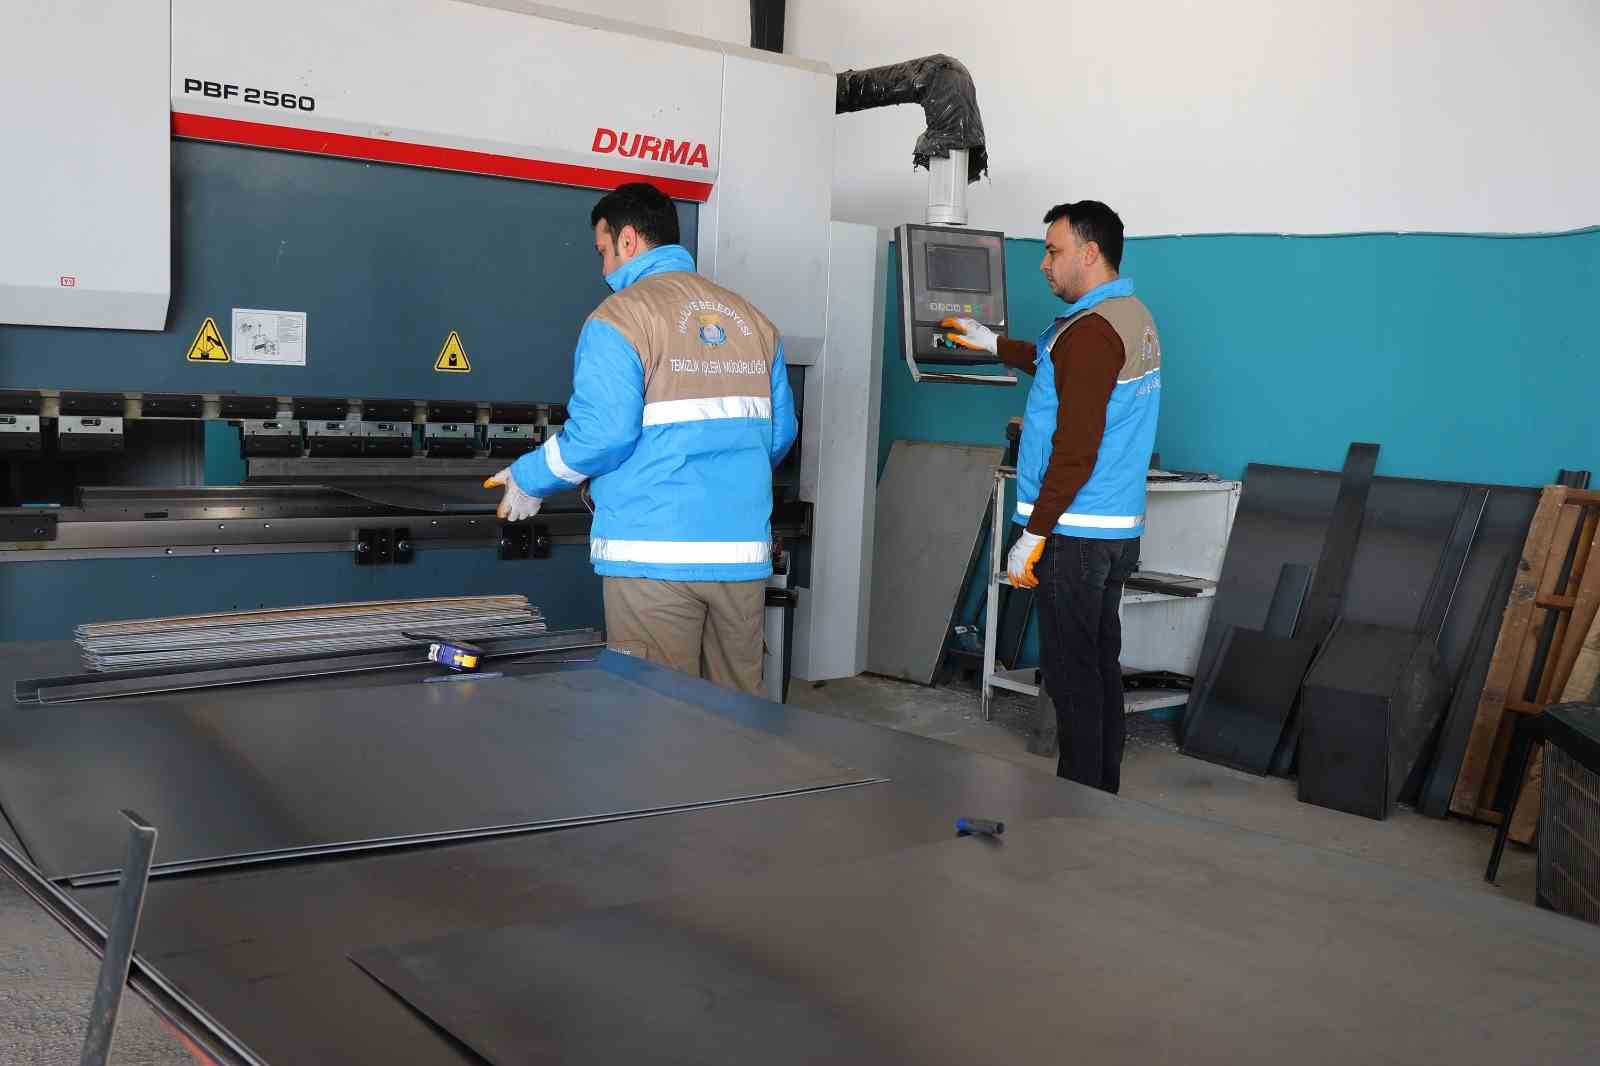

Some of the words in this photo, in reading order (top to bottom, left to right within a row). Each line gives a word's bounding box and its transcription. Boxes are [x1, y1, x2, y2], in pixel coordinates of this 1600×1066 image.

[184, 78, 239, 100] PBF
[244, 87, 315, 112] 2560
[591, 127, 709, 169] DURMA
